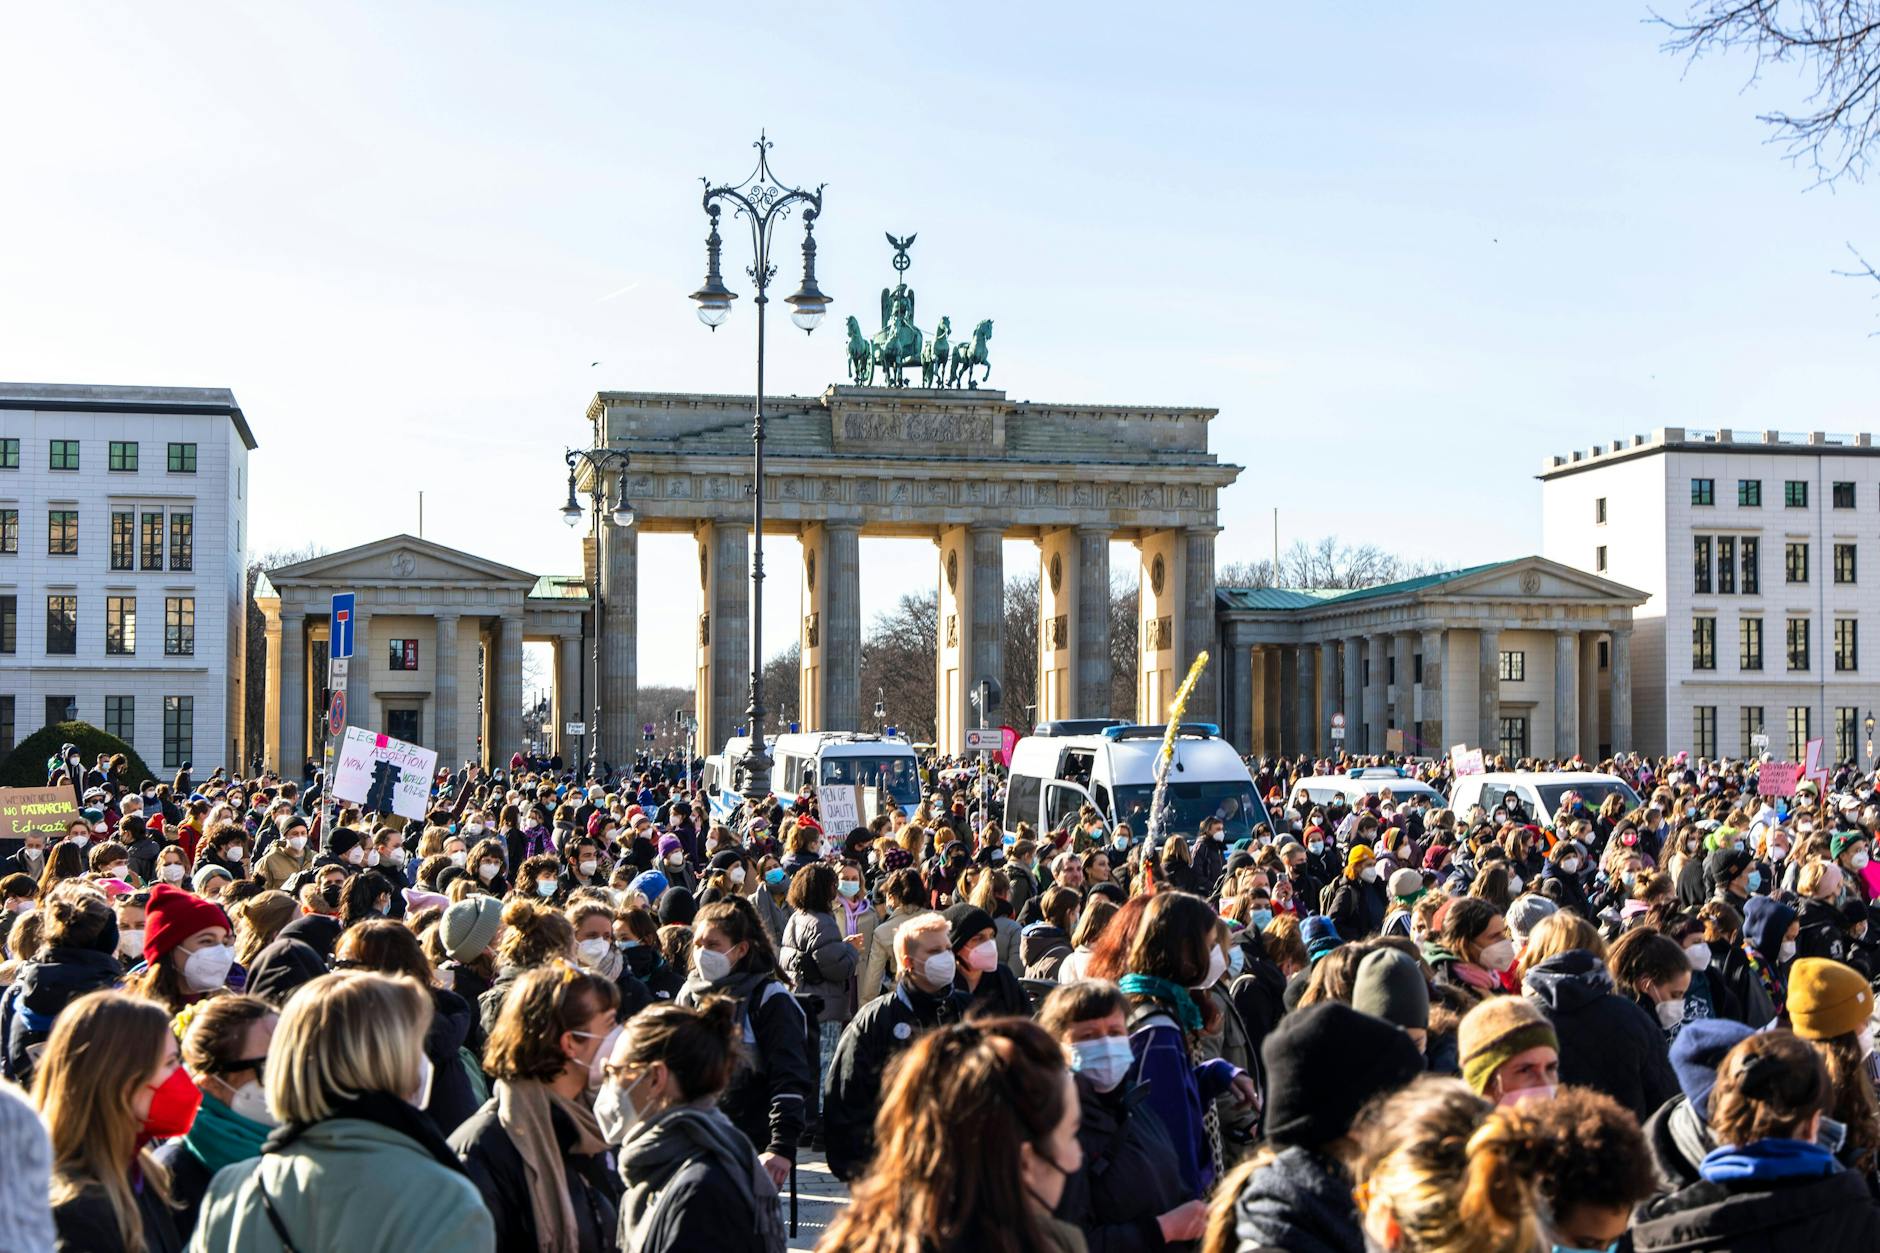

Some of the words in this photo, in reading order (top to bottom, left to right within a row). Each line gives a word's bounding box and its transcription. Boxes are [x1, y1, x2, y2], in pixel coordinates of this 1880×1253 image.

[347, 727, 418, 756] LEGALIZE
[343, 757, 367, 771] NOW
[369, 747, 427, 770] ABORTION
[402, 771, 427, 785] WORLD
[820, 787, 836, 802] MEN
[838, 787, 847, 801] OF
[3, 806, 18, 816] NO
[21, 801, 77, 815] PATRIARCHAL
[827, 803, 855, 818] QUALITY
[824, 820, 834, 833] DO
[834, 820, 845, 831] NOT
